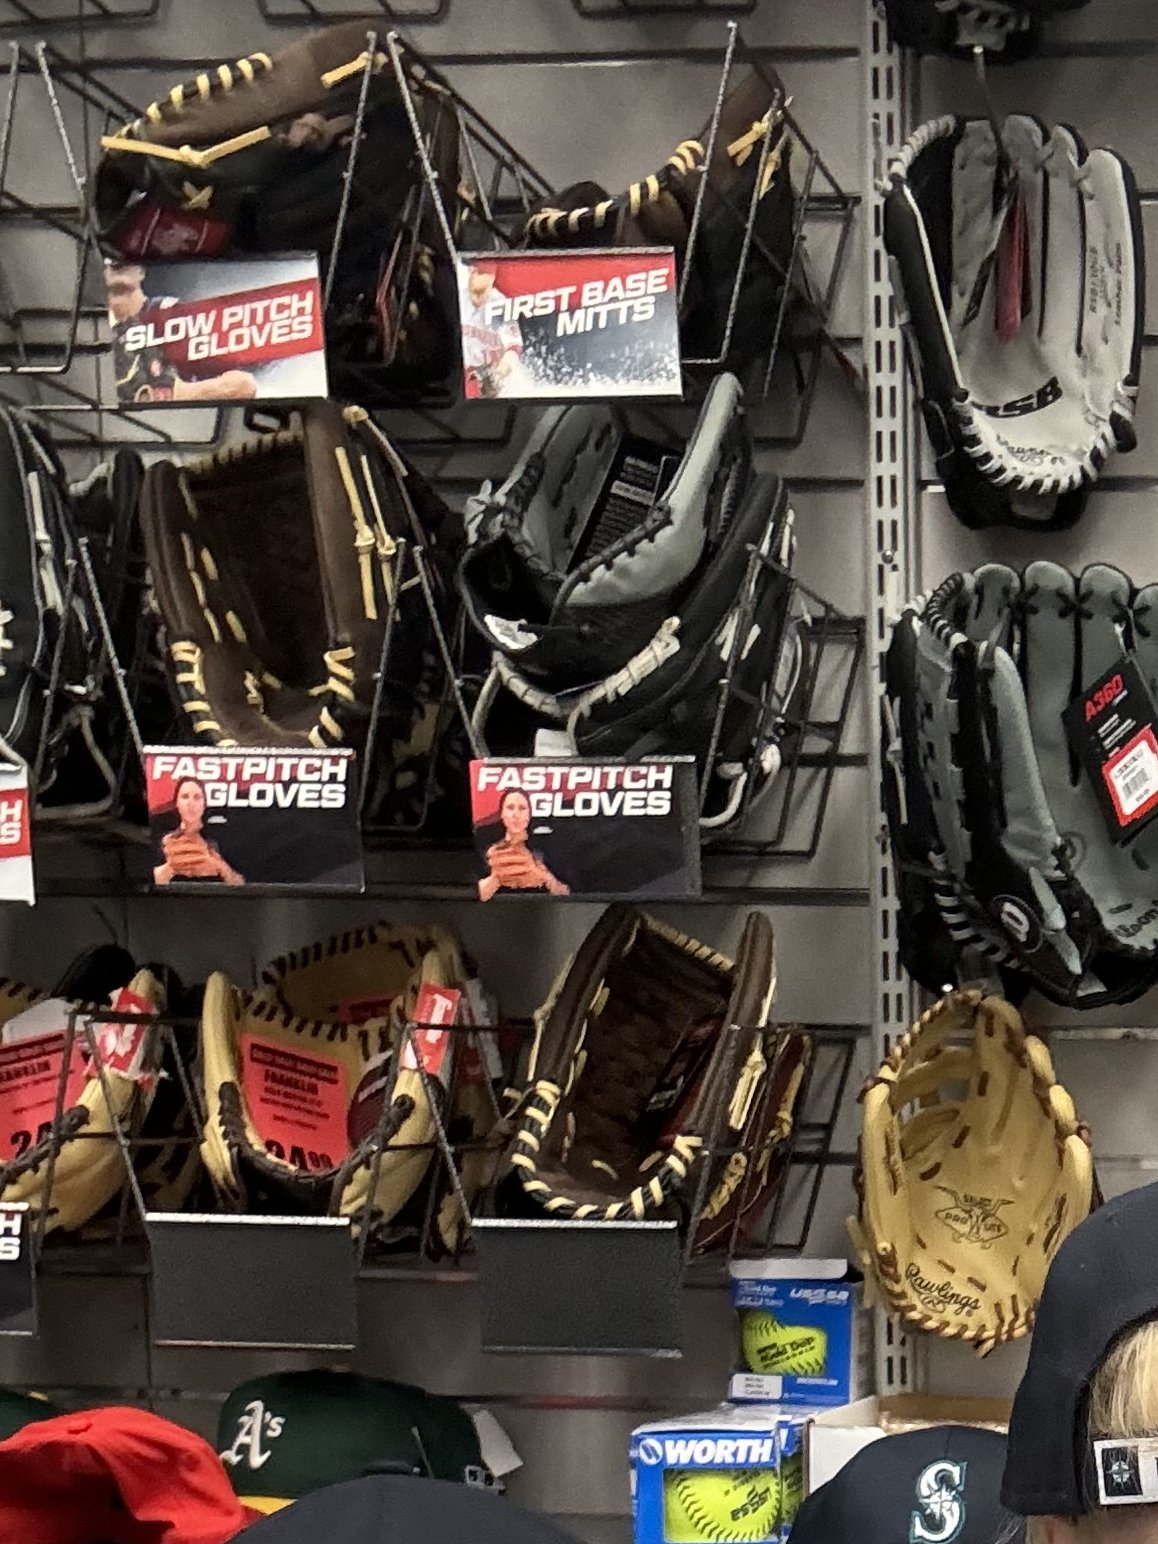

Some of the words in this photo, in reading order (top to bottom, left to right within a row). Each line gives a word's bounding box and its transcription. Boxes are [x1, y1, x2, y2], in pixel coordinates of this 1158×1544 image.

[484, 286, 577, 326] FIRST
[580, 268, 669, 308] BASE
[556, 296, 656, 337] MITTS
[124, 310, 217, 351] SLOW
[221, 290, 314, 332] PITCH
[187, 315, 314, 361] GLOVES
[1085, 674, 1124, 722] A360
[152, 756, 347, 781] FASTPITCH
[477, 764, 673, 791] FASTPITCH
[204, 782, 346, 808] GLOVES
[530, 790, 672, 817] GLOVES
[905, 1262, 981, 1316] Rawlings
[219, 1400, 287, 1470] A's
[664, 1439, 774, 1465] WORTH
